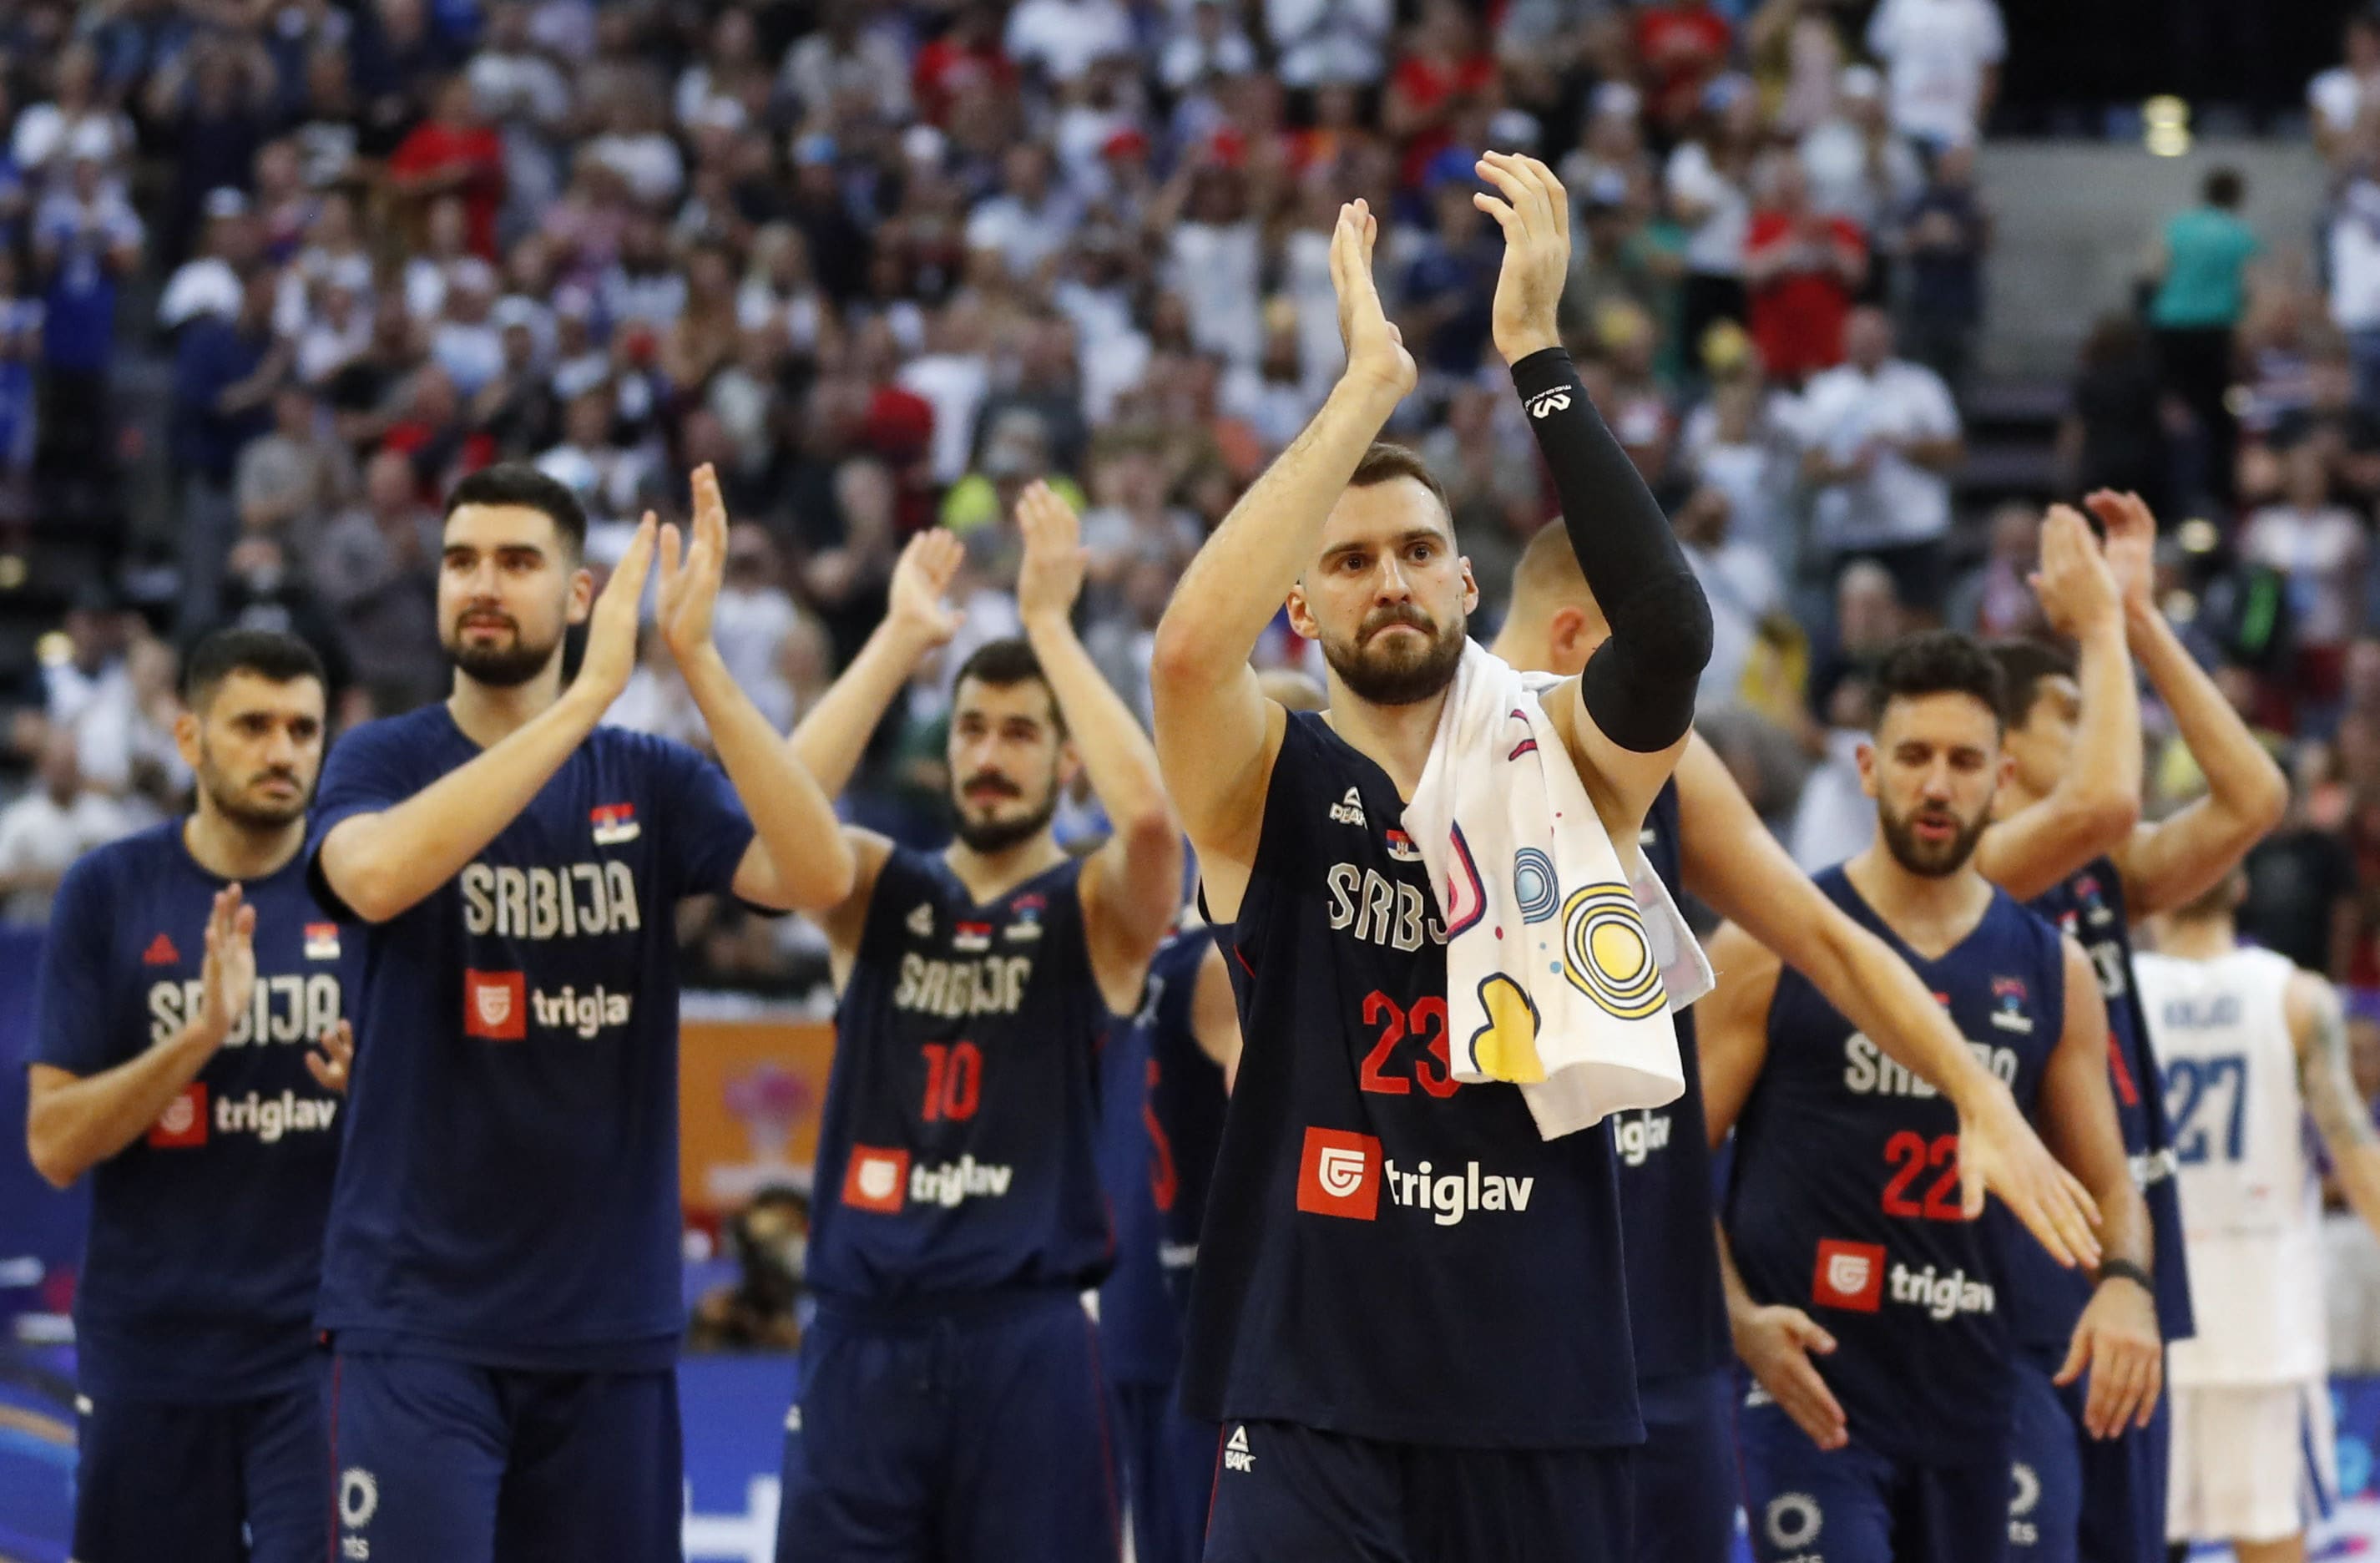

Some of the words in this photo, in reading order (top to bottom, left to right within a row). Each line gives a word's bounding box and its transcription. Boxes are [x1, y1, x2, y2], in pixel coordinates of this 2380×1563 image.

[460, 859, 641, 941] SRBIJA
[531, 983, 633, 1039] trigla
[1359, 989, 1463, 1099] 23
[215, 1088, 337, 1145] triglav
[921, 1040, 983, 1122] 10
[2168, 1055, 2248, 1163] 27
[1612, 1109, 1672, 1166] iglav
[910, 1154, 1013, 1207] triglav
[1384, 1159, 1534, 1227] triglav
[1882, 1130, 1965, 1222] 22
